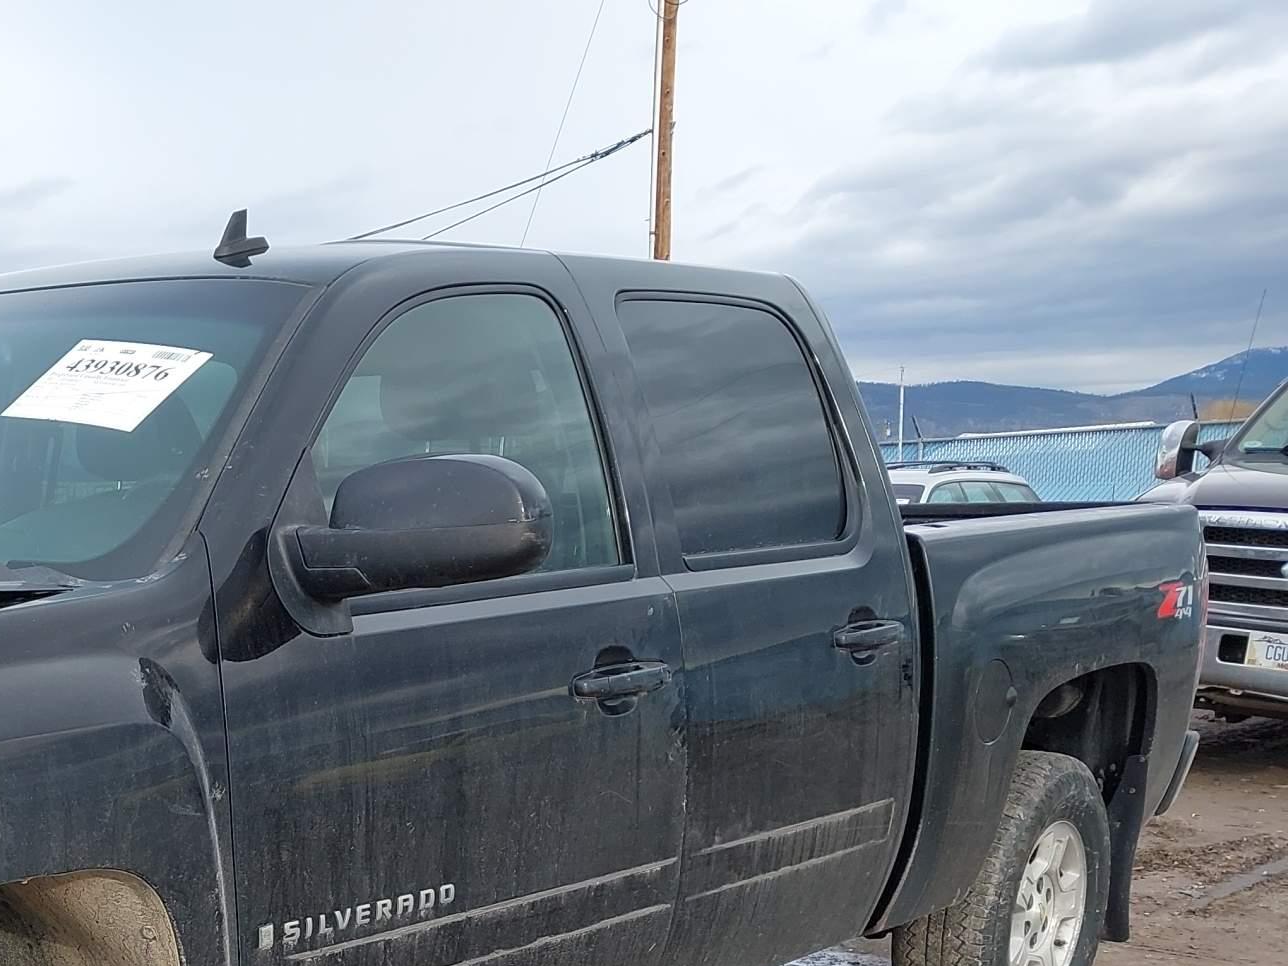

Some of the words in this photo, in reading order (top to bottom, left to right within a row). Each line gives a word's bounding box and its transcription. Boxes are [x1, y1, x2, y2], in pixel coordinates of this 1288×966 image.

[66, 358, 176, 382] 43930876
[1157, 582, 1193, 619] Z71
[282, 883, 455, 946] SILVERADO
